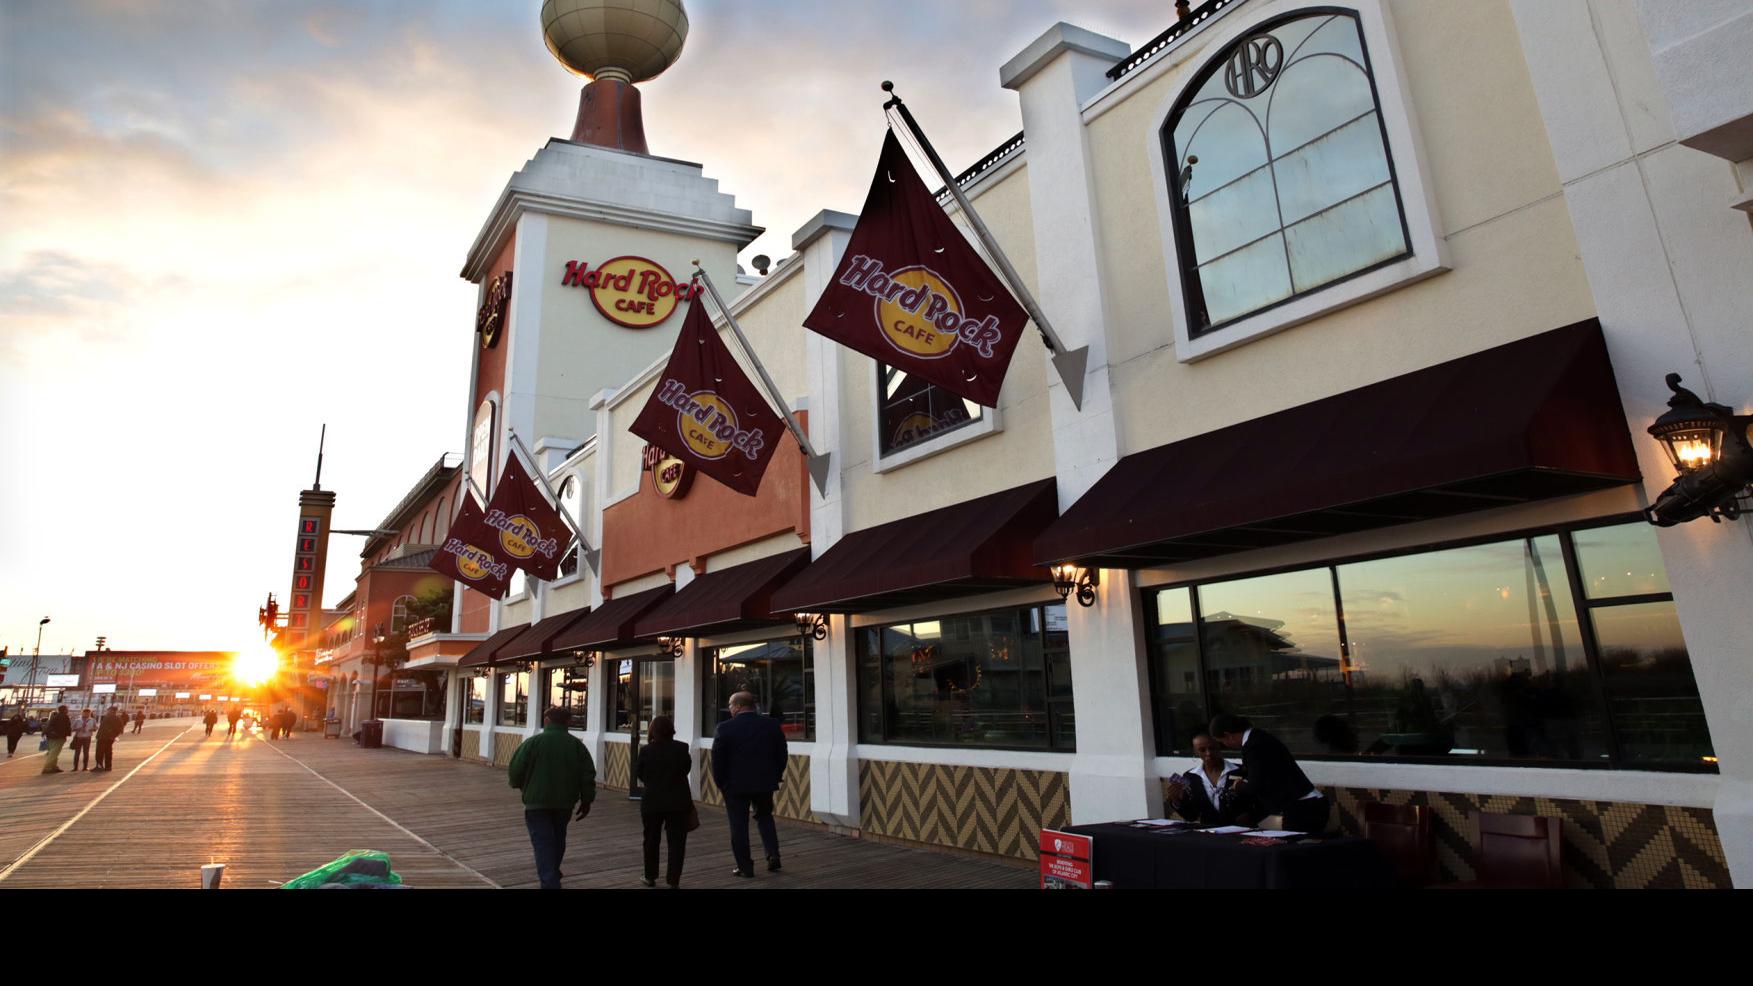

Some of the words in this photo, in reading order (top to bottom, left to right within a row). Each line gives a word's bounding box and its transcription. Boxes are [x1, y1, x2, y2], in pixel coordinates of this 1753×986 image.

[561, 260, 636, 292] Hard
[638, 269, 704, 302] Rock
[615, 298, 655, 315] CAFE
[839, 255, 929, 314] Hard
[924, 293, 1001, 358] Rock
[893, 319, 935, 346] CAFE
[657, 379, 717, 425] Hard
[707, 410, 764, 460] Rock
[689, 428, 714, 450] CAFE
[484, 509, 525, 536] Hard
[521, 528, 557, 559] Rock
[444, 538, 478, 560] Hard
[475, 553, 507, 580] Rock
[115, 662, 128, 670] NJ
[129, 662, 163, 670] CASINO
[164, 662, 188, 670] SLOT
